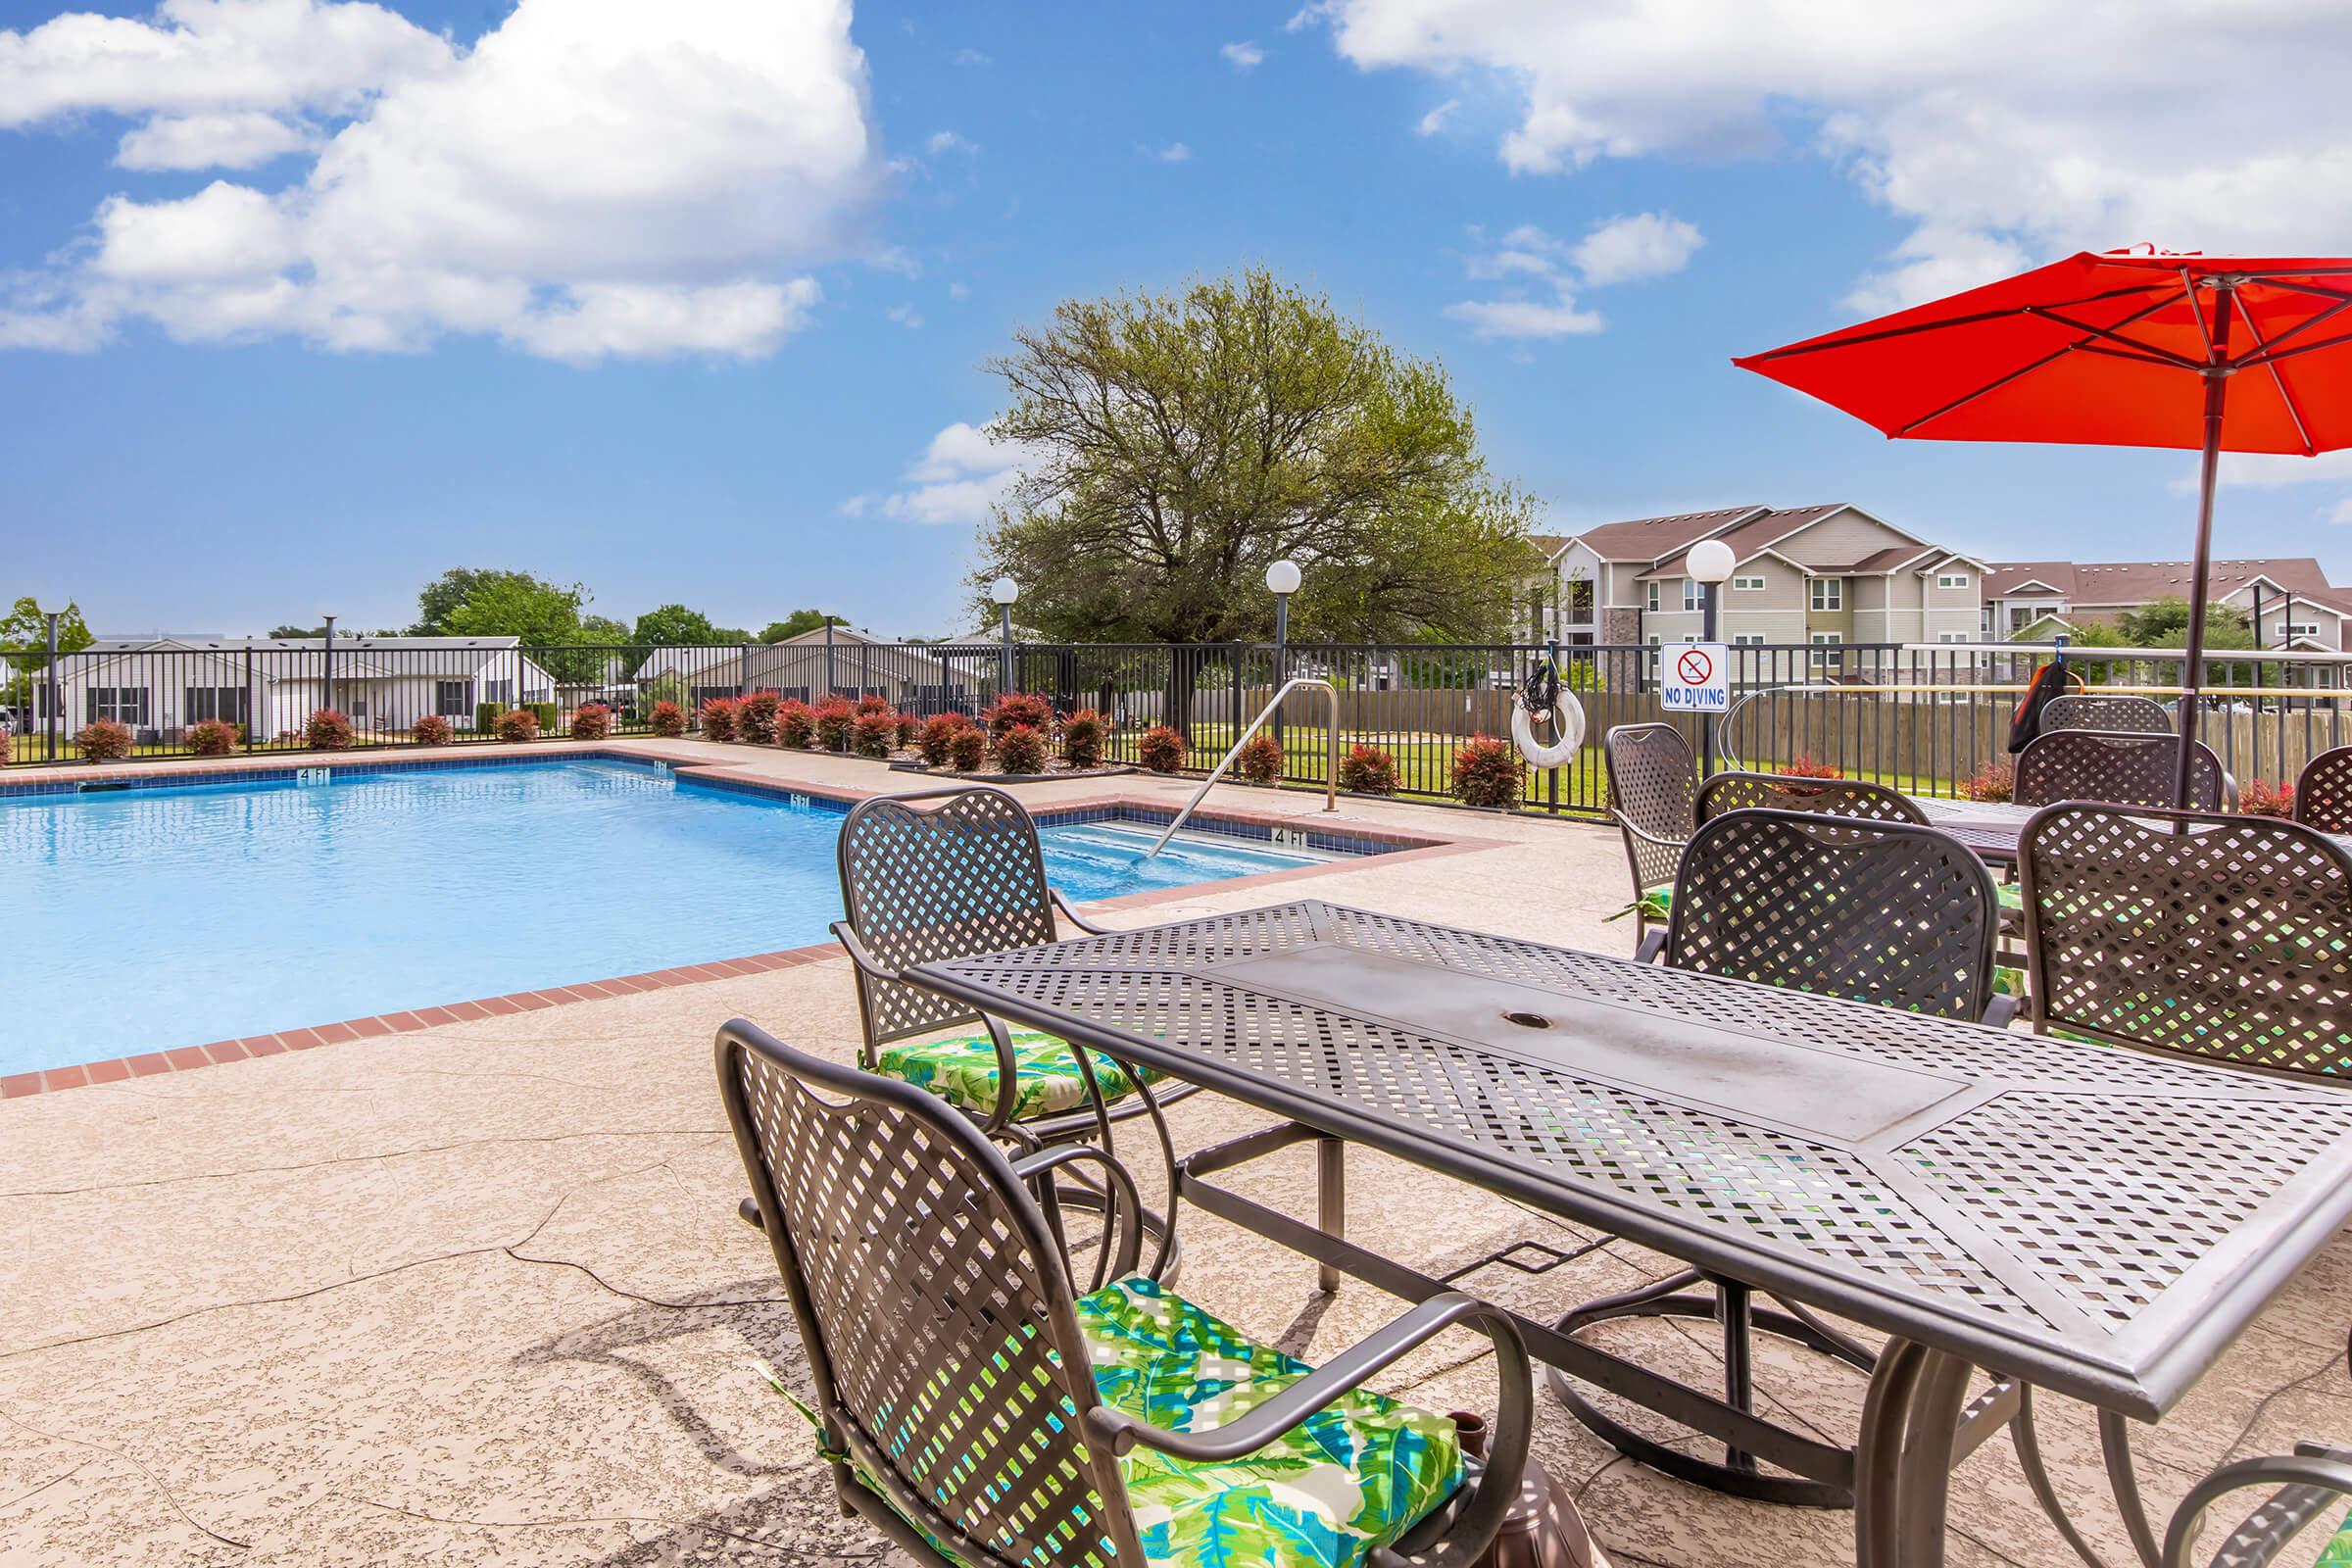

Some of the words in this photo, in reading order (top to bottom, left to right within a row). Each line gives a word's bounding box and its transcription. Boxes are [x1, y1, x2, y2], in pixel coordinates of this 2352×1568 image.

[1665, 687, 1681, 704] NO
[1685, 688, 1725, 706] DIVING
[300, 768, 309, 778] 4
[1275, 829, 1285, 843] 4
[1291, 830, 1303, 847] FT
